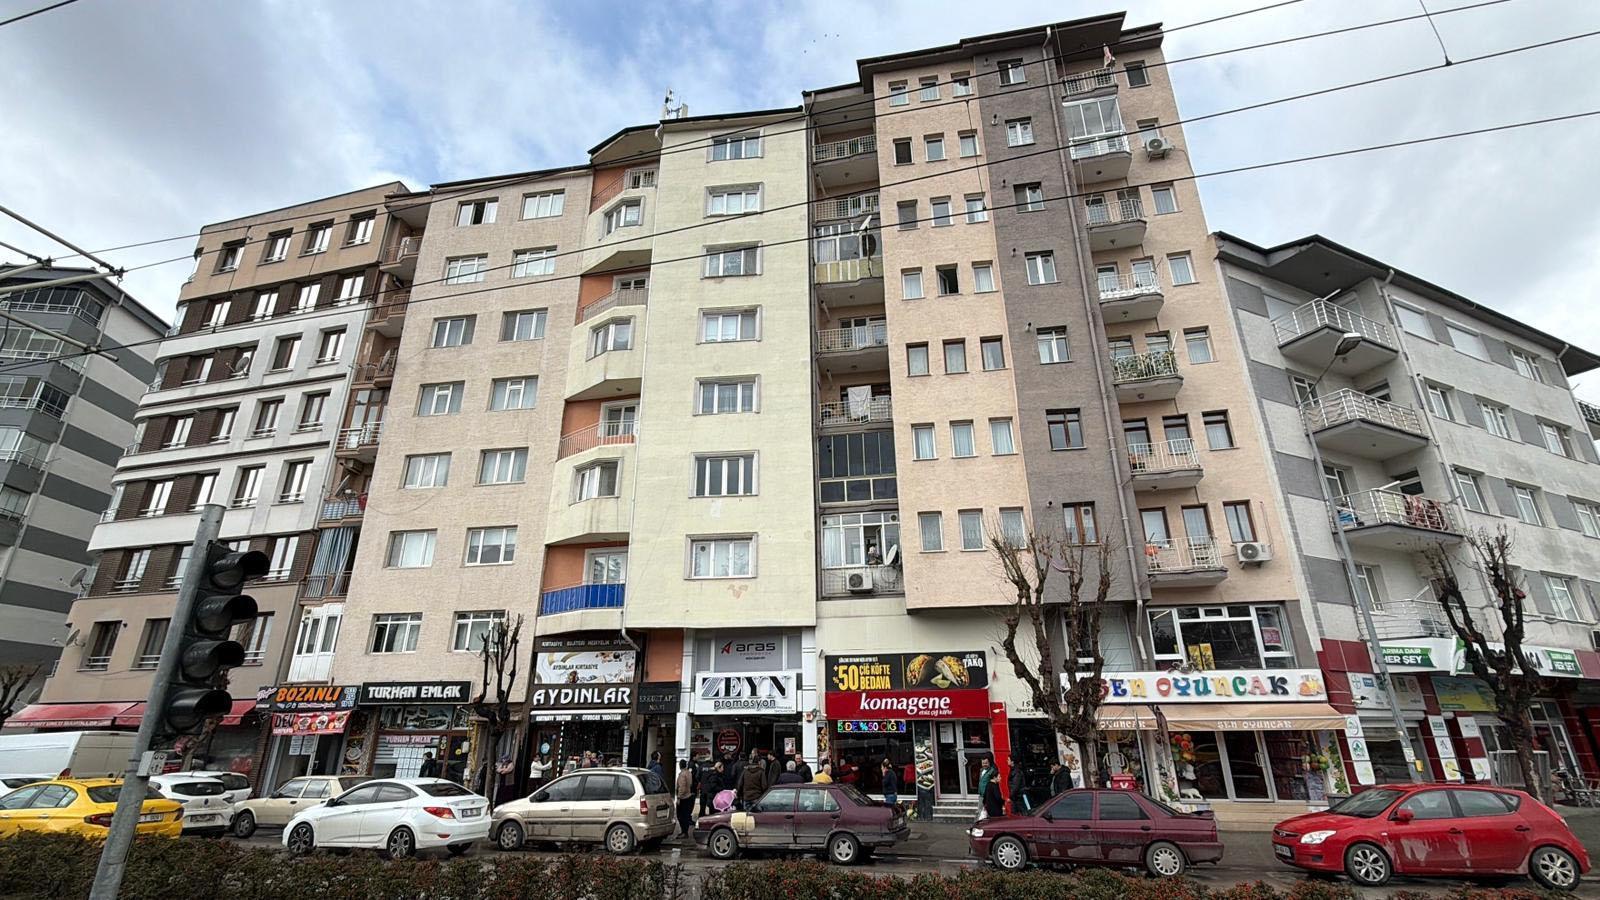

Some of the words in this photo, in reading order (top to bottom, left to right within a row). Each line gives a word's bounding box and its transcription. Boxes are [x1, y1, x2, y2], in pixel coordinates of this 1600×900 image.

[736, 643, 775, 652] aras
[962, 658, 983, 668] TAKO
[1402, 655, 1422, 665] ŞEY
[701, 675, 791, 699] ZEYN
[860, 676, 891, 690] BEDAVA
[1156, 674, 1290, 698] OYUNCAK
[276, 687, 342, 702] BOZANLI
[368, 687, 417, 699] TURHAN
[421, 686, 462, 699] EMLAK
[533, 687, 631, 706] AYDINLAR
[714, 698, 776, 711] promosyon
[860, 692, 951, 715] komagene
[1242, 720, 1292, 729] OYUNCAK
